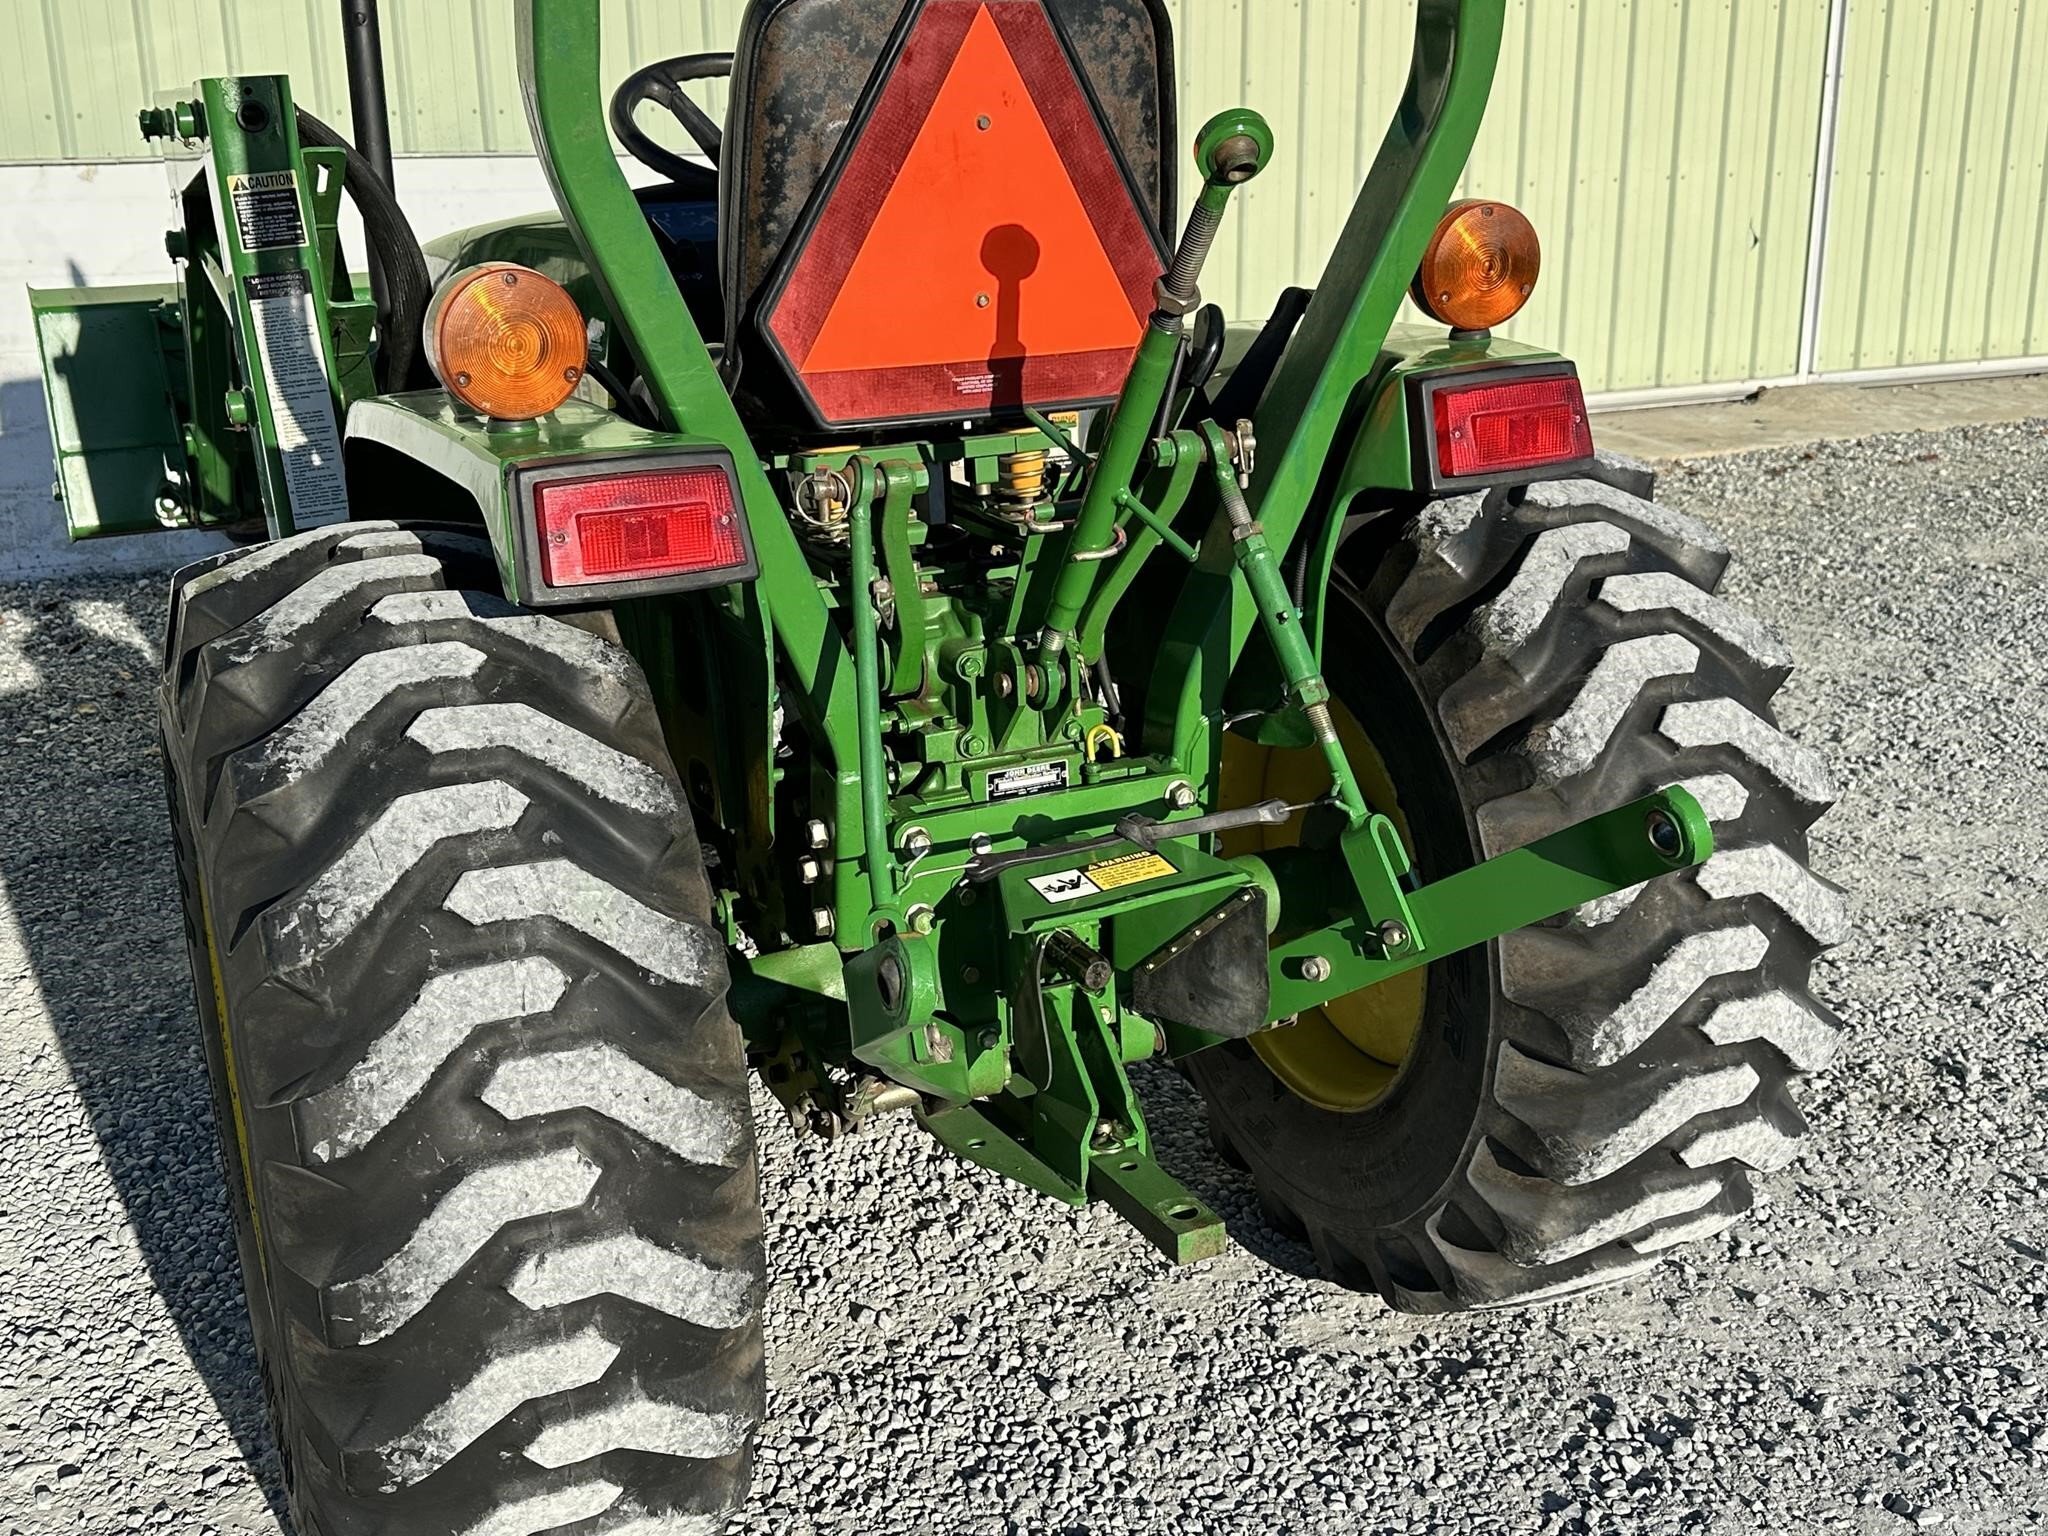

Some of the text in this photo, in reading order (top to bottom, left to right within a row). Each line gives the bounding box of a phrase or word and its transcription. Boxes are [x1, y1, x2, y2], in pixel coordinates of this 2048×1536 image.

[248, 174, 294, 189] CAUTION
[1004, 768, 1025, 778] JOHN
[1026, 764, 1051, 774] DEERE
[1097, 851, 1151, 867] WARNING
